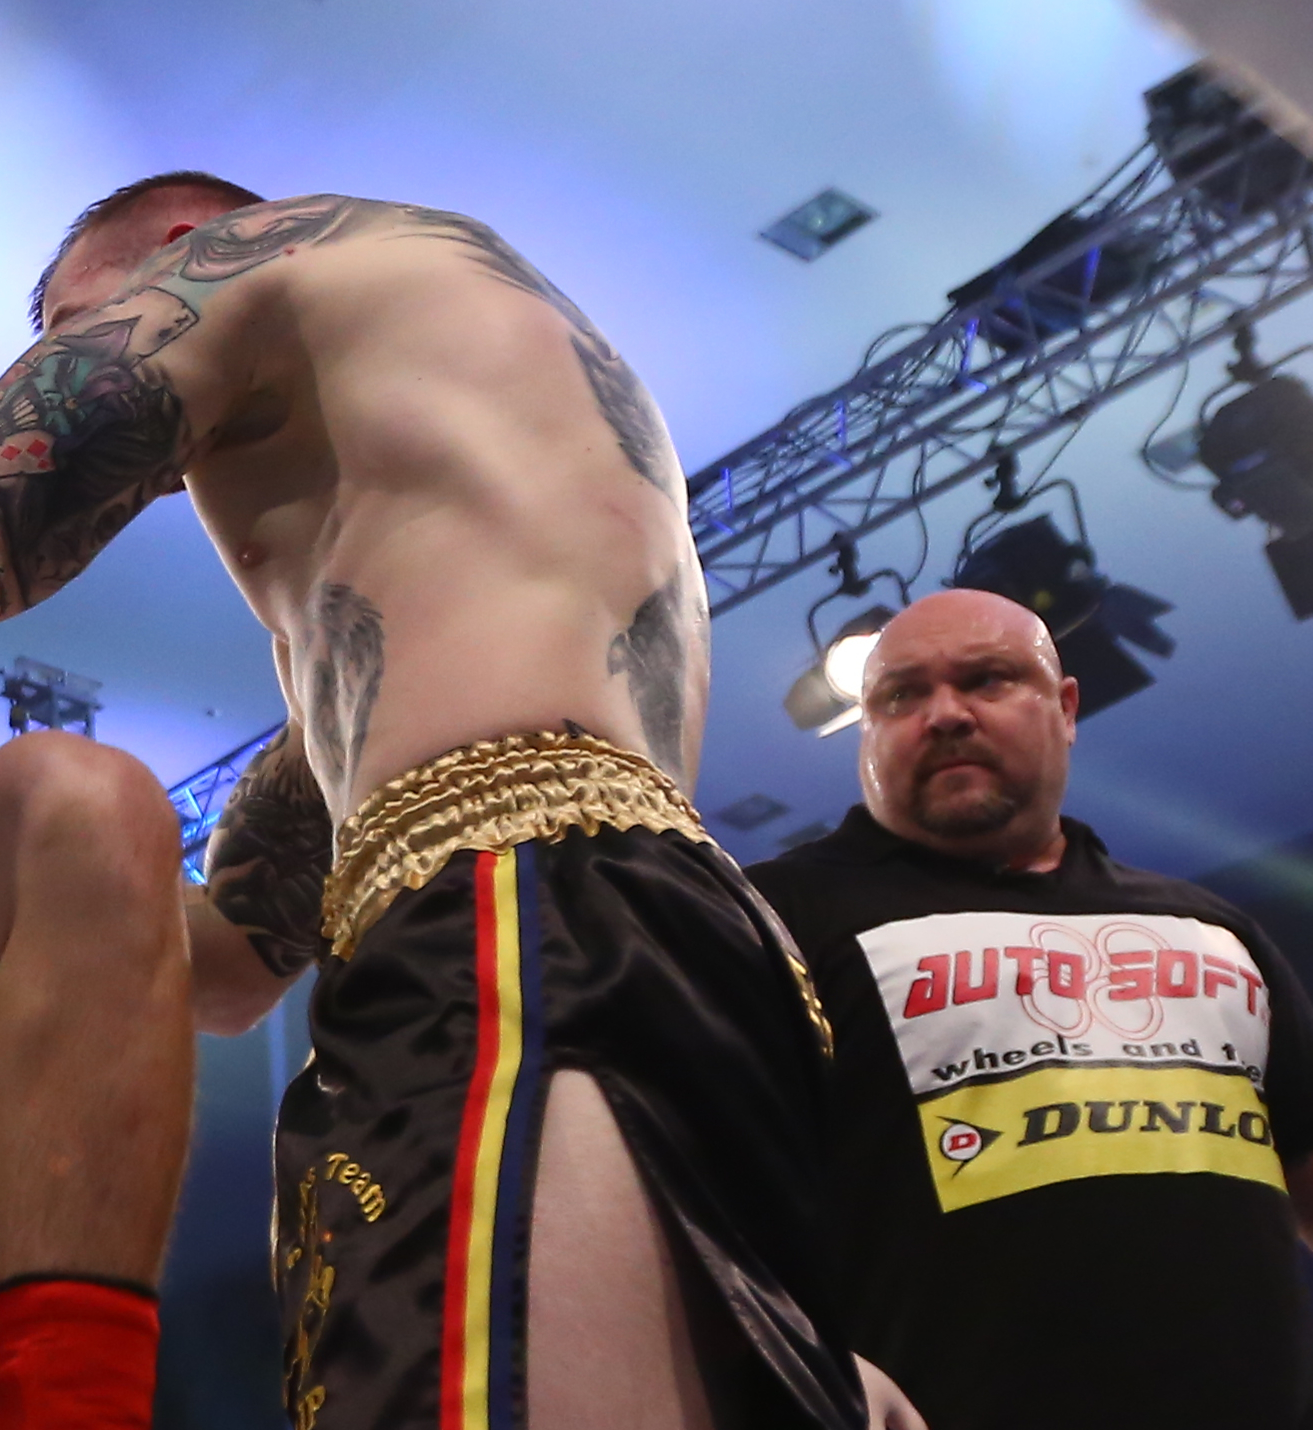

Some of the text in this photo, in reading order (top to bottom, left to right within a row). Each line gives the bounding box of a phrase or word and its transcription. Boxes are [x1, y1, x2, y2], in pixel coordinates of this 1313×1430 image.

[1108, 948, 1264, 1017] SOFT
[932, 1034, 1093, 1084] wheels
[1123, 1038, 1202, 1060] and
[947, 1132, 976, 1153] D
[325, 1152, 387, 1223] Team
